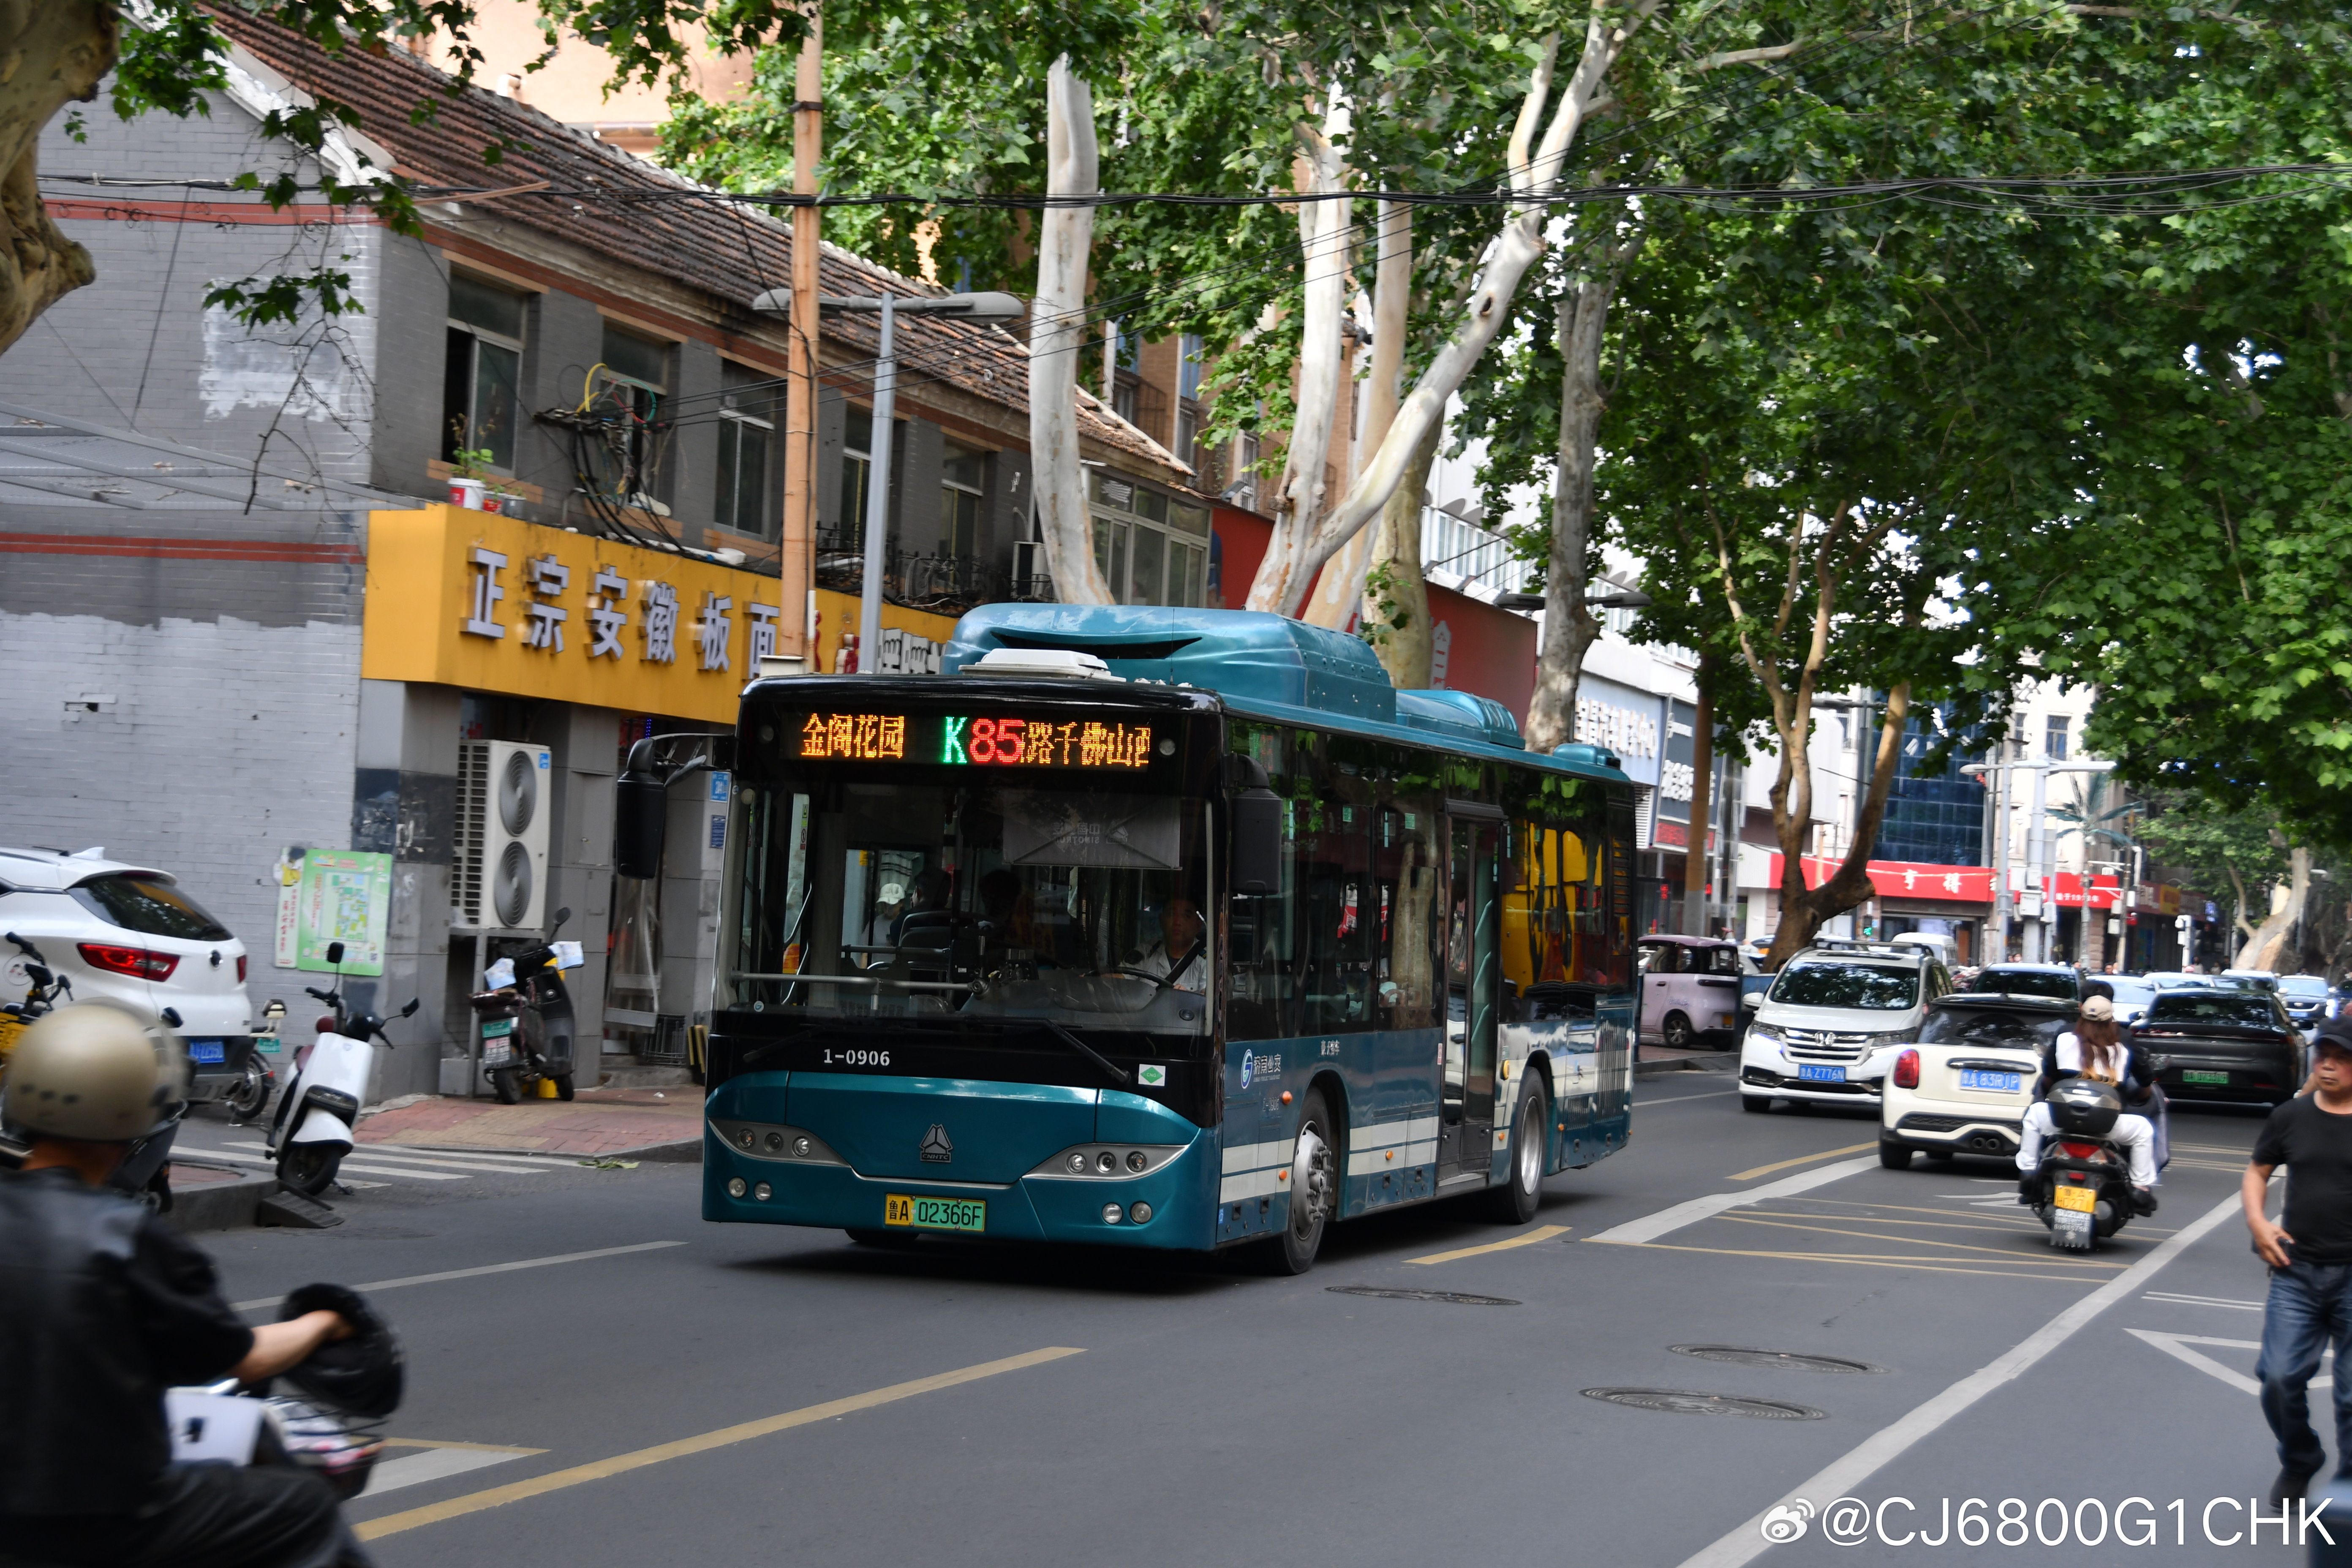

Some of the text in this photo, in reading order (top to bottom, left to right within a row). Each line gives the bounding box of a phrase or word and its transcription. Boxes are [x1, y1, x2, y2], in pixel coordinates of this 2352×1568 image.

[463, 547, 780, 680] 正宗安徽板面
[801, 713, 904, 759] 金阁花园
[824, 1049, 890, 1066] 1-0906
[1253, 1054, 1281, 1075] 济南公交
